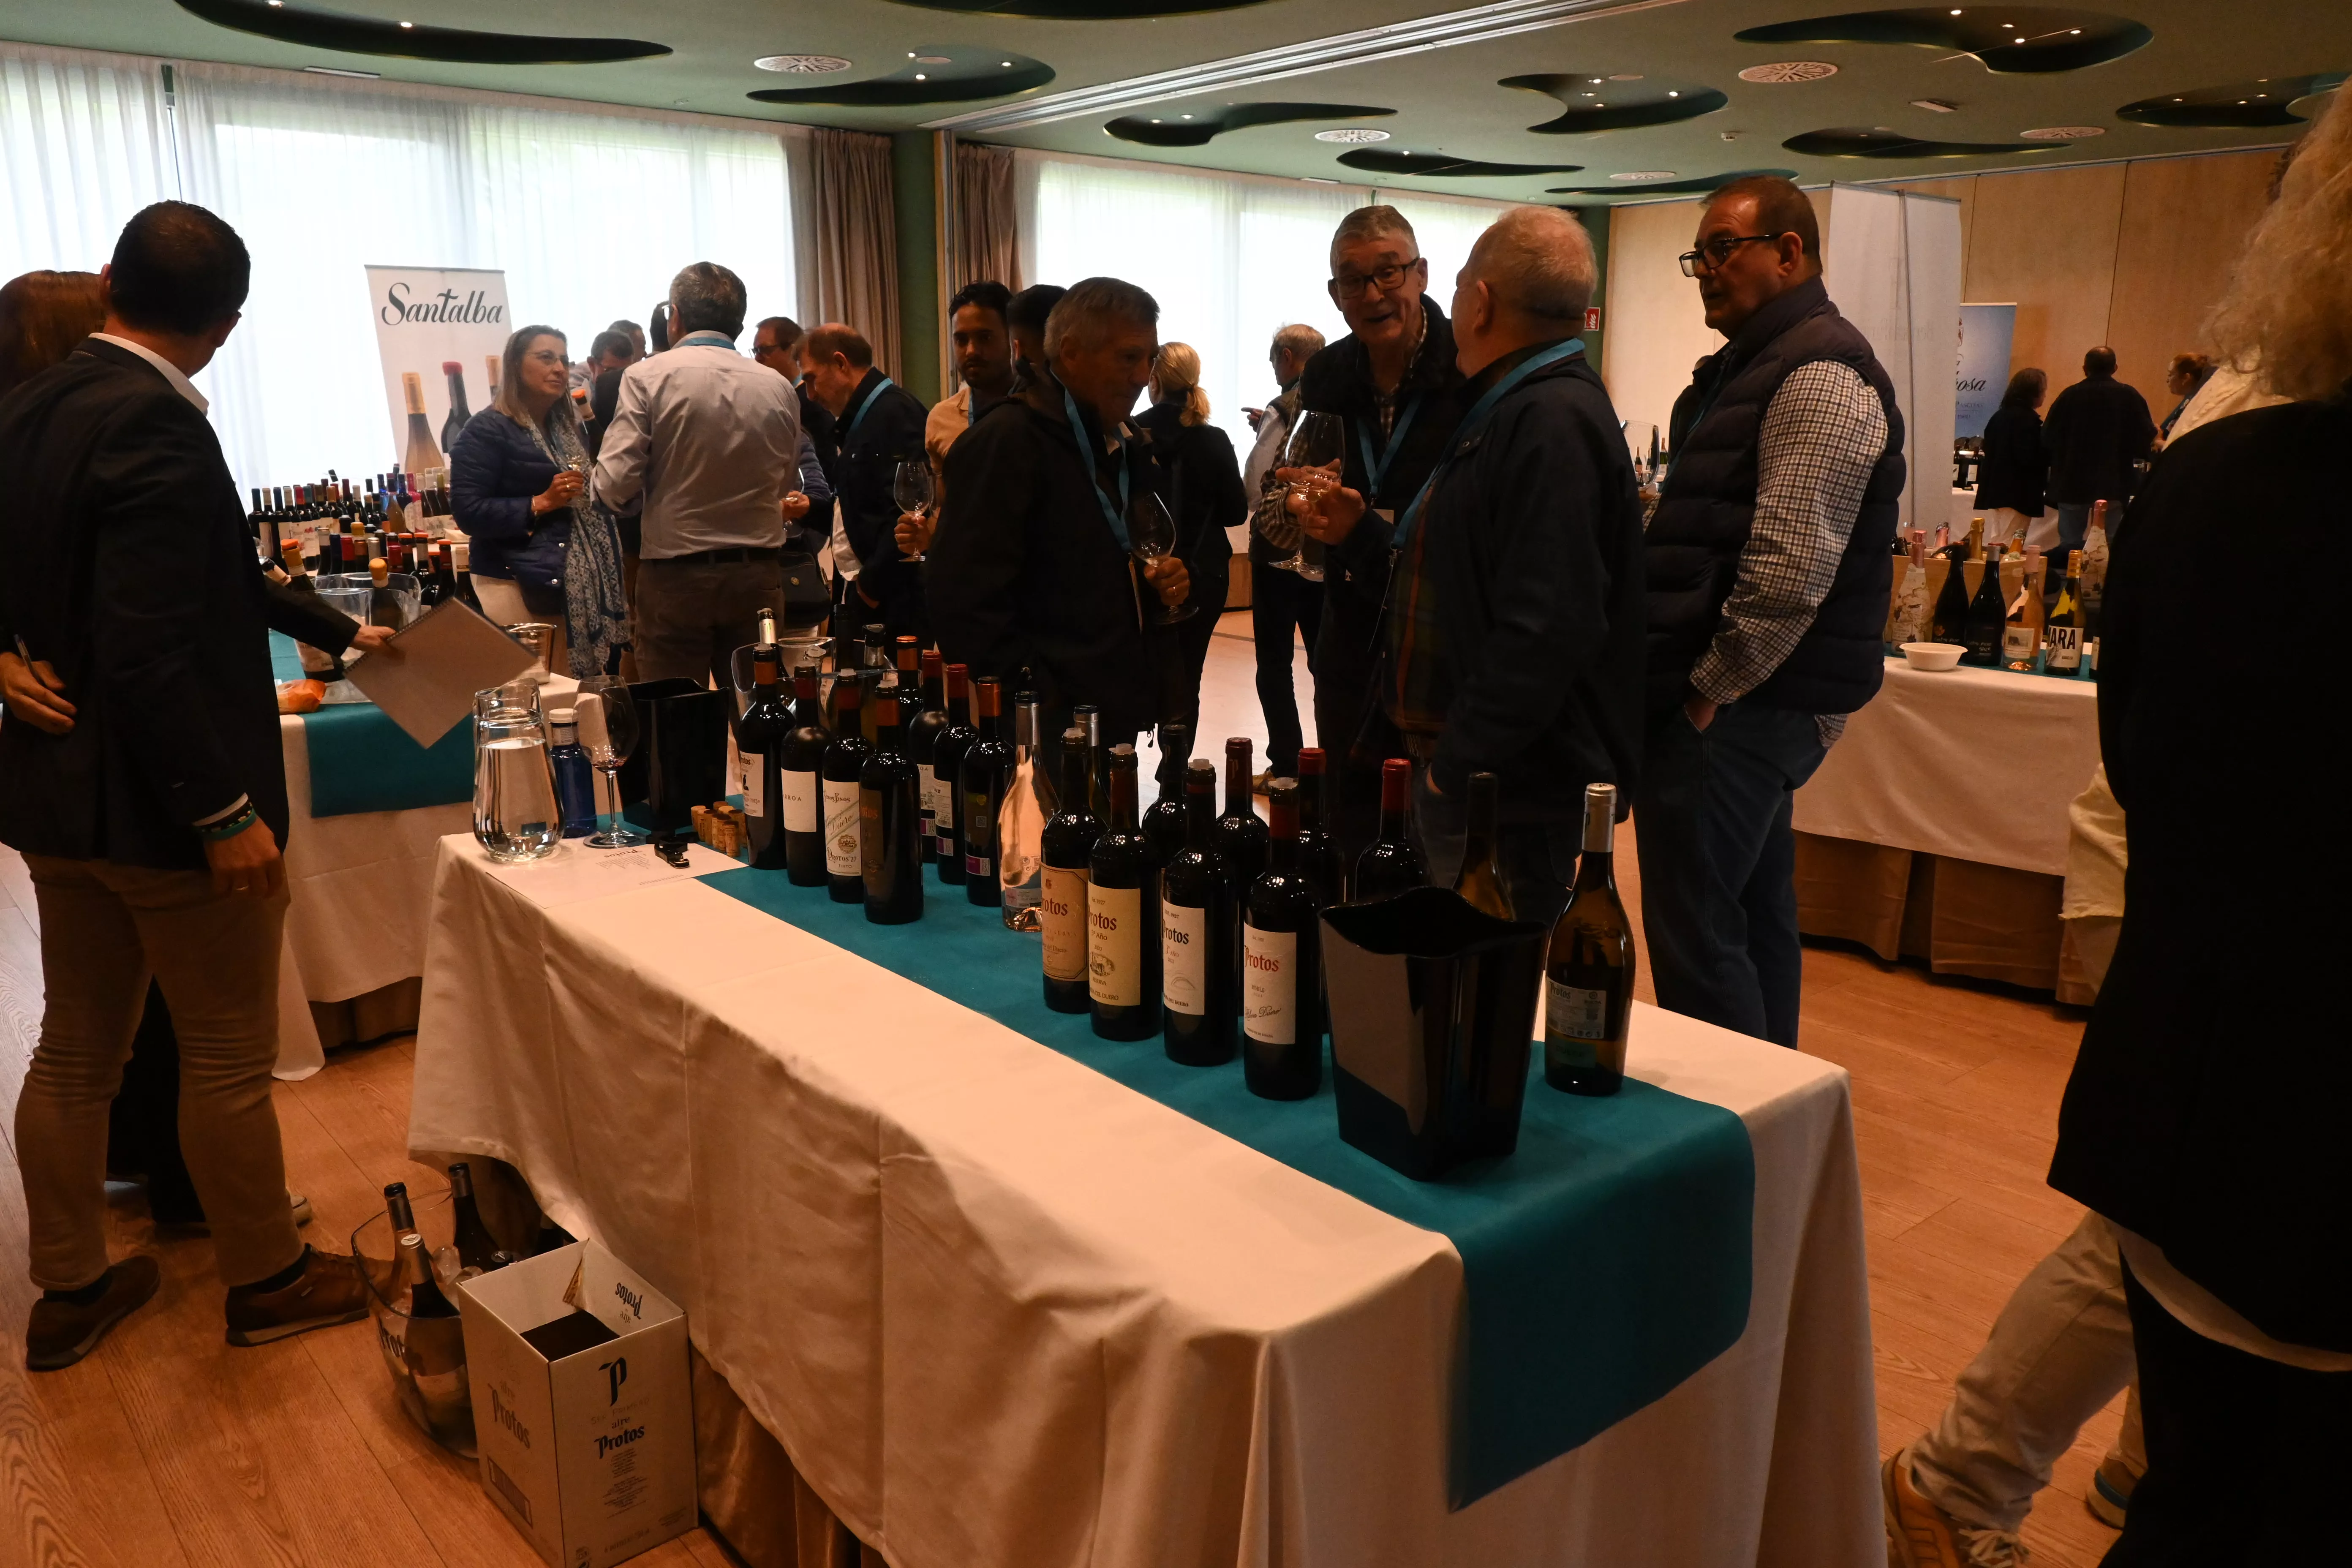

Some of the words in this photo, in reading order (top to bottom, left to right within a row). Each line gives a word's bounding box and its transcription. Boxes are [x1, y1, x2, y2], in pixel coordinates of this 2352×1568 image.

[381, 282, 503, 326] Santalba
[1956, 378, 1986, 391] osa
[2049, 627, 2075, 650] ARA
[604, 849, 642, 858] Protos
[1042, 898, 1068, 916] rotos
[1096, 932, 1108, 941] Año
[1244, 945, 1279, 972] Protos
[1550, 981, 1571, 999] Protos
[615, 1282, 642, 1320] Protos
[598, 1357, 627, 1407] P
[487, 1383, 531, 1449] Protos
[612, 1416, 630, 1429] aire
[594, 1426, 645, 1459] Protos
